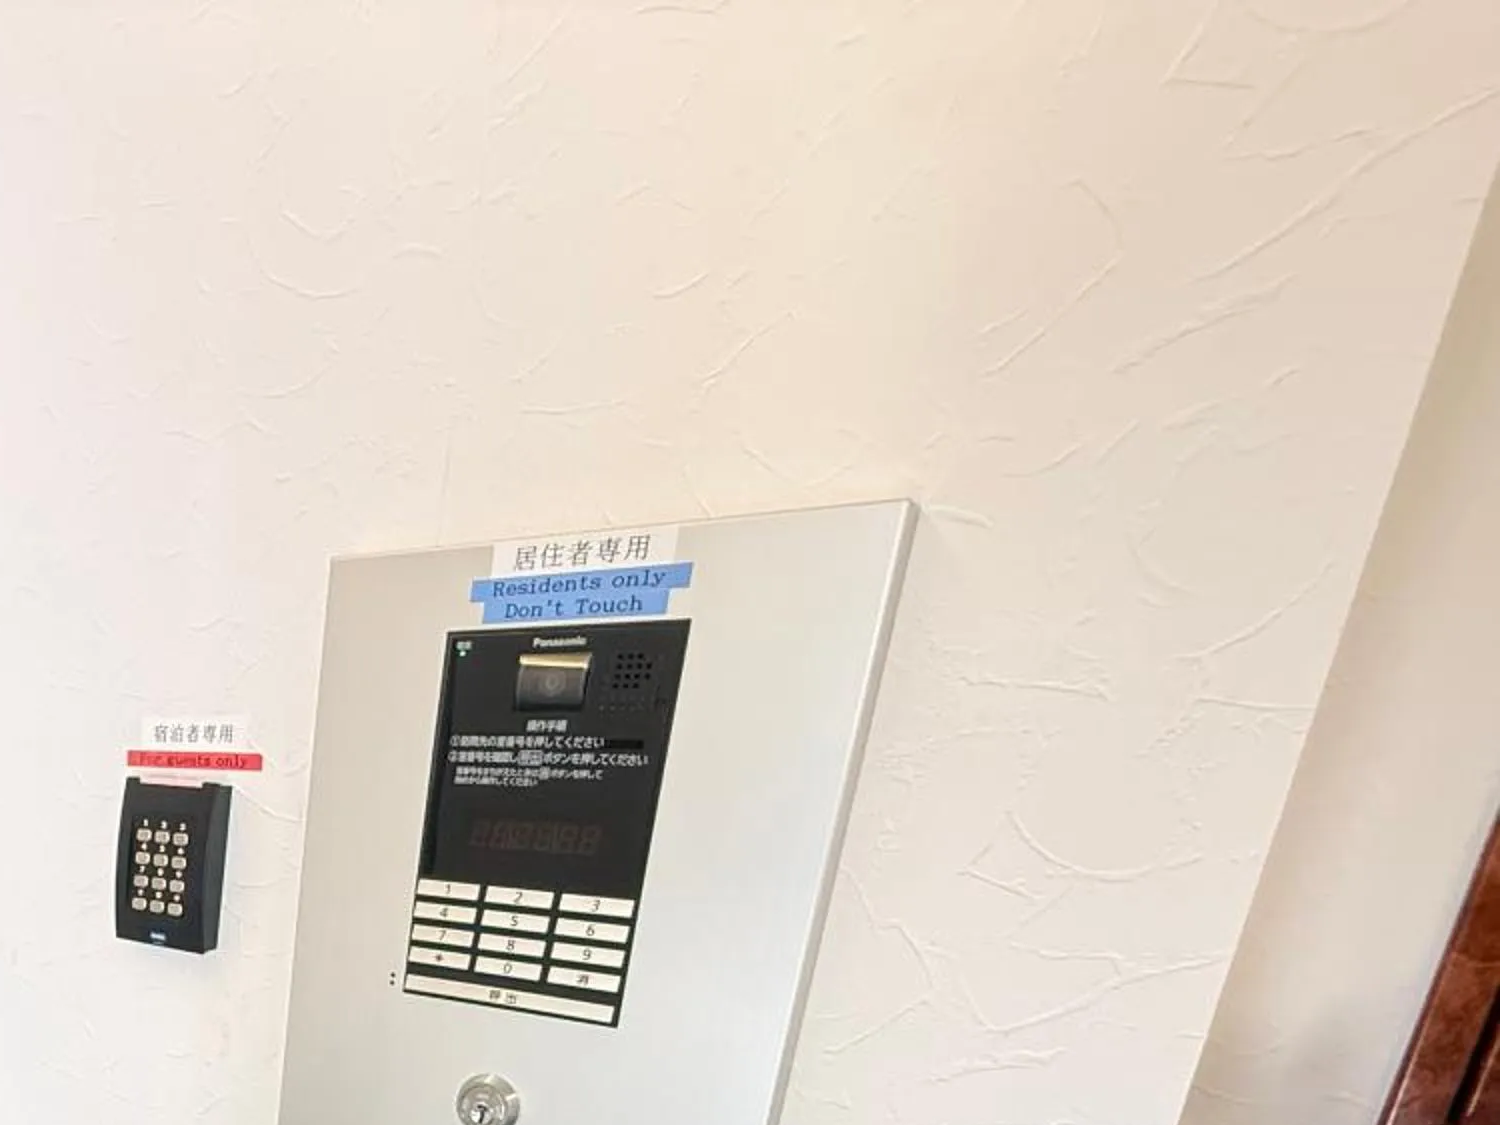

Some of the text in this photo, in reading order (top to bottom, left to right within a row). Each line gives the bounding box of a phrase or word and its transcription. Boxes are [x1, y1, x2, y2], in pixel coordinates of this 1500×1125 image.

[514, 534, 651, 571] 居住者専用
[493, 569, 667, 598] Residents only
[505, 596, 643, 619] Don't Touch
[532, 636, 587, 649] Panasonic
[154, 723, 234, 743] 宿泊者専用
[167, 755, 211, 767] guests
[216, 755, 247, 769] only
[513, 892, 523, 903] 2
[590, 900, 600, 912] 3
[439, 908, 448, 918] 4
[510, 915, 518, 926] 5
[439, 930, 447, 940] 7
[585, 925, 595, 936] 6
[506, 940, 515, 951] 8
[582, 950, 591, 960] 9
[503, 964, 512, 974] 0
